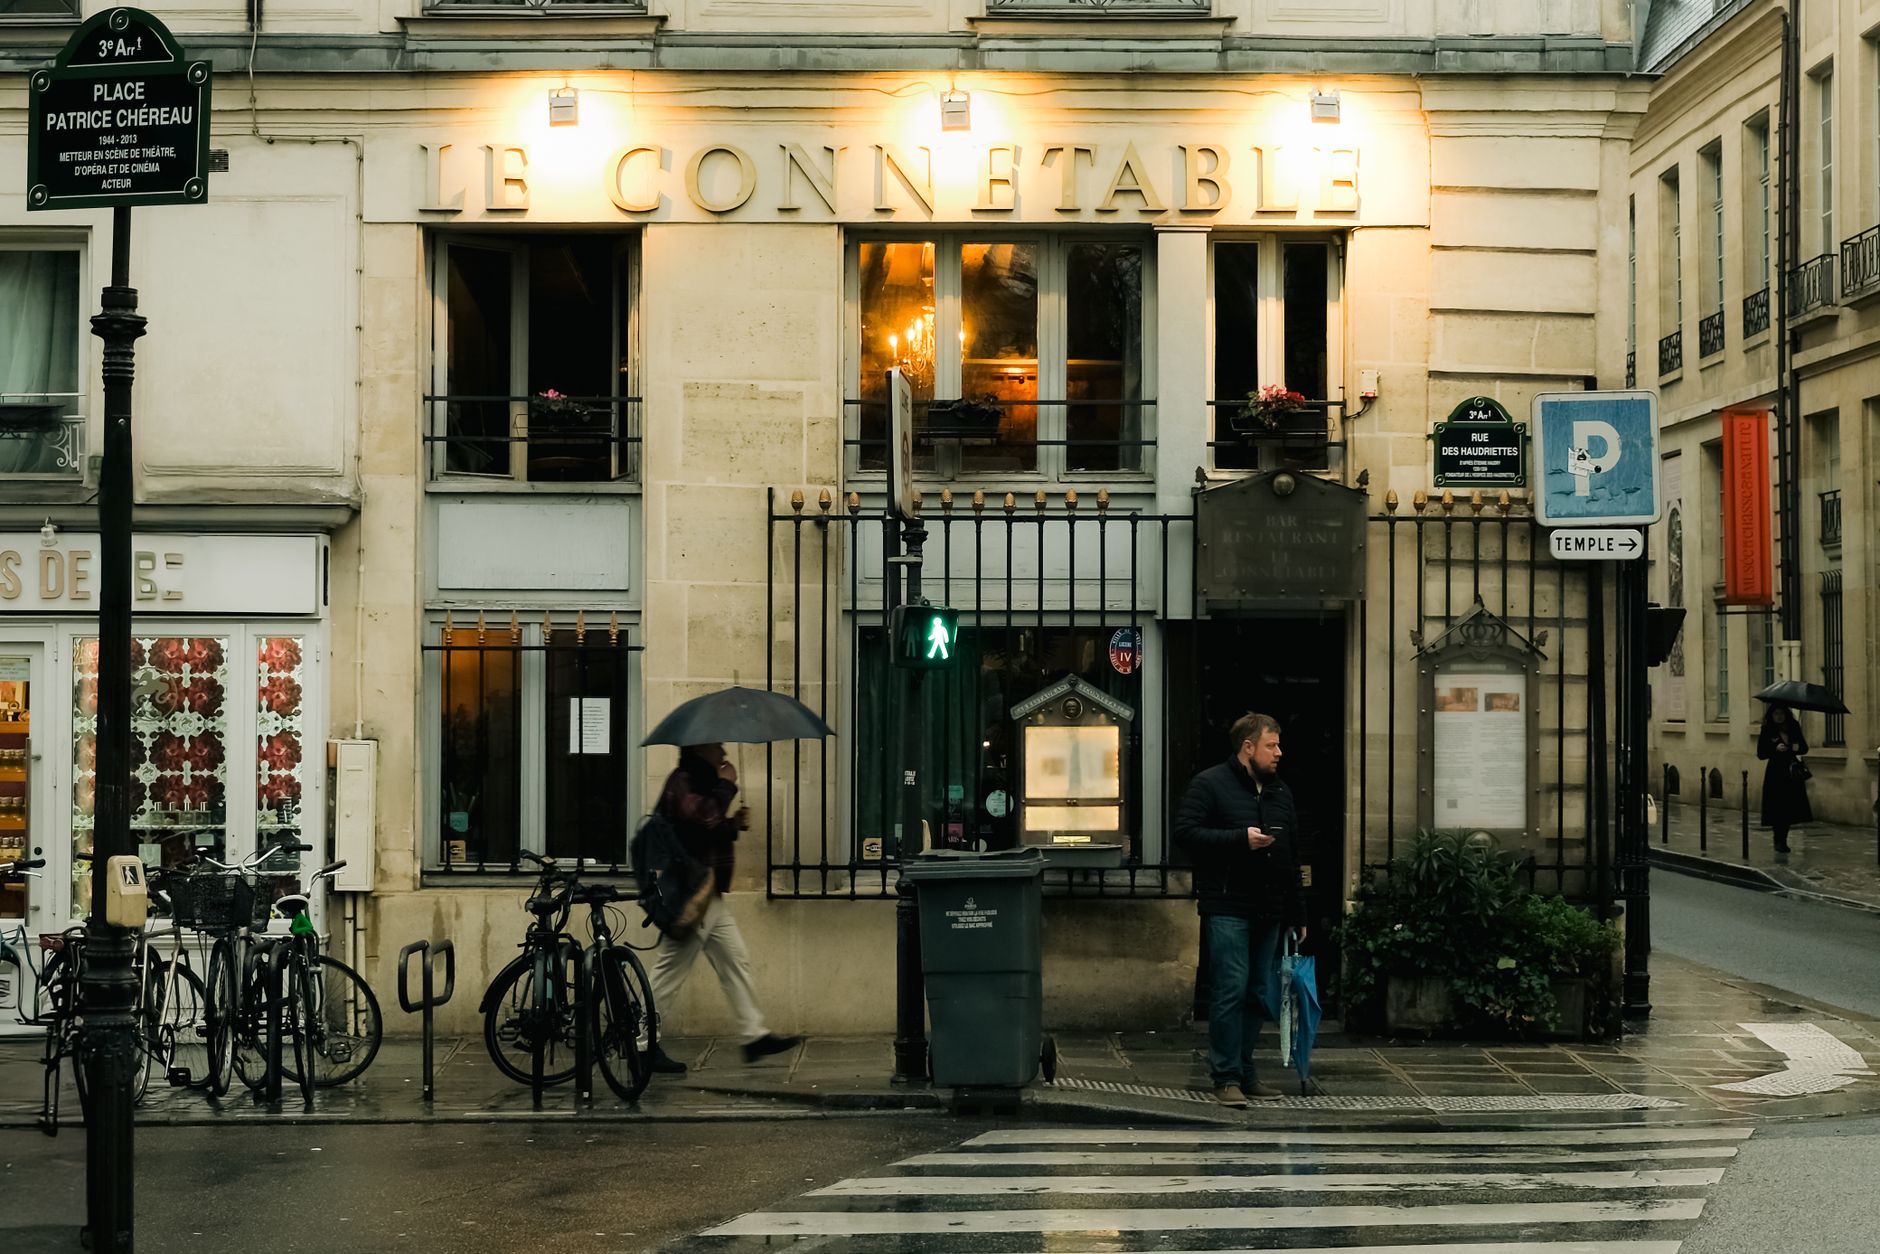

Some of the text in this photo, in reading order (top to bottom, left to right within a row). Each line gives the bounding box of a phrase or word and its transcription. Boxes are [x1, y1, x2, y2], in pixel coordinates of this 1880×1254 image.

[94, 82, 145, 102] PLACE
[46, 104, 193, 131] PATRICE CHÉREAU
[99, 135, 115, 145] 1944
[120, 135, 138, 145] 2013
[59, 151, 93, 162] METTEUR
[94, 150, 103, 160] EN
[104, 148, 129, 160] SCÈNE
[130, 149, 140, 159] DE
[74, 160, 160, 176] D'OPÉRA ET DE CINÉMA
[101, 178, 132, 189] ACTEUR
[418, 141, 1361, 216] LE CONNETABLE
[1471, 433, 1489, 442] RUE
[1442, 446, 1519, 456] DES HAUDRIETTES
[1573, 420, 1622, 497] P
[1265, 515, 1298, 527] BAR
[1222, 531, 1338, 544] RESTAURANT
[1555, 537, 1614, 551] TEMPLE
[39, 550, 91, 600] DE
[1120, 652, 1132, 662] IV
